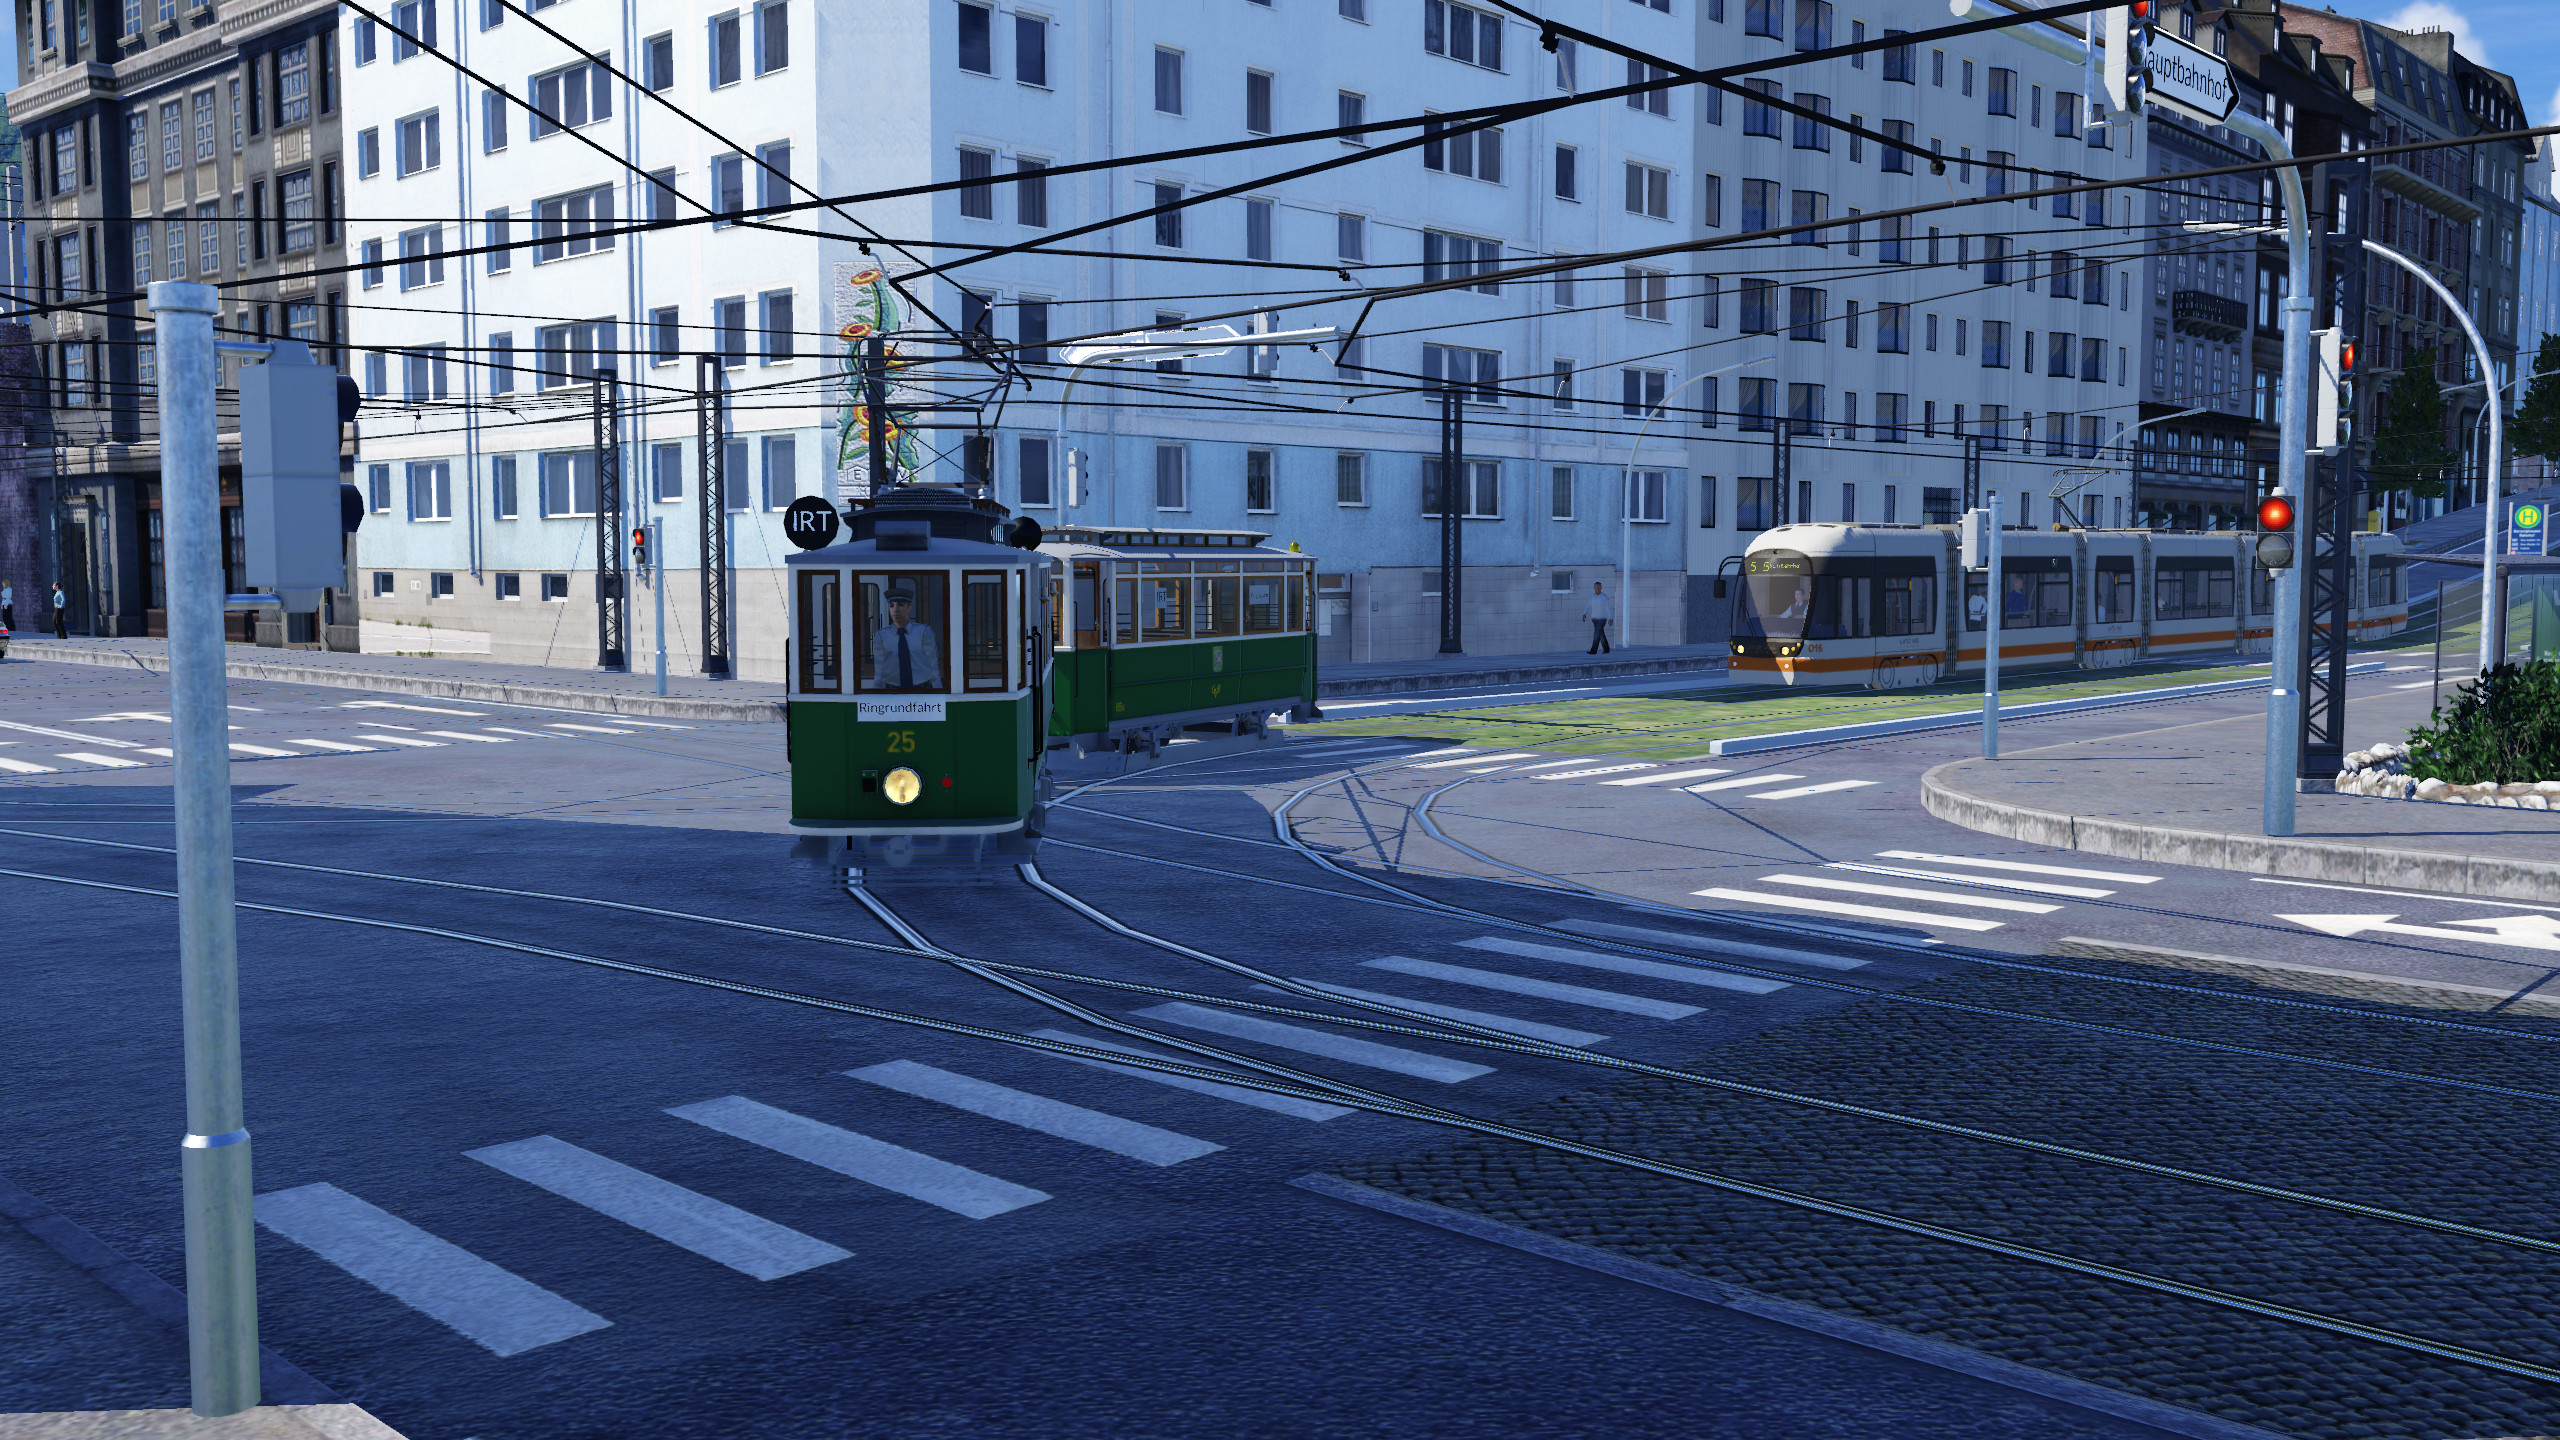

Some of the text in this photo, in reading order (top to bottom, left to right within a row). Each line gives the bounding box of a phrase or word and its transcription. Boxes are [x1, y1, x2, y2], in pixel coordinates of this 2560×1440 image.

[2145, 51, 2228, 103] auptbahnhof
[793, 511, 832, 532] IRT
[2522, 510, 2534, 524] H
[859, 701, 942, 716] Ringrundfahrt
[887, 730, 916, 753] 25
